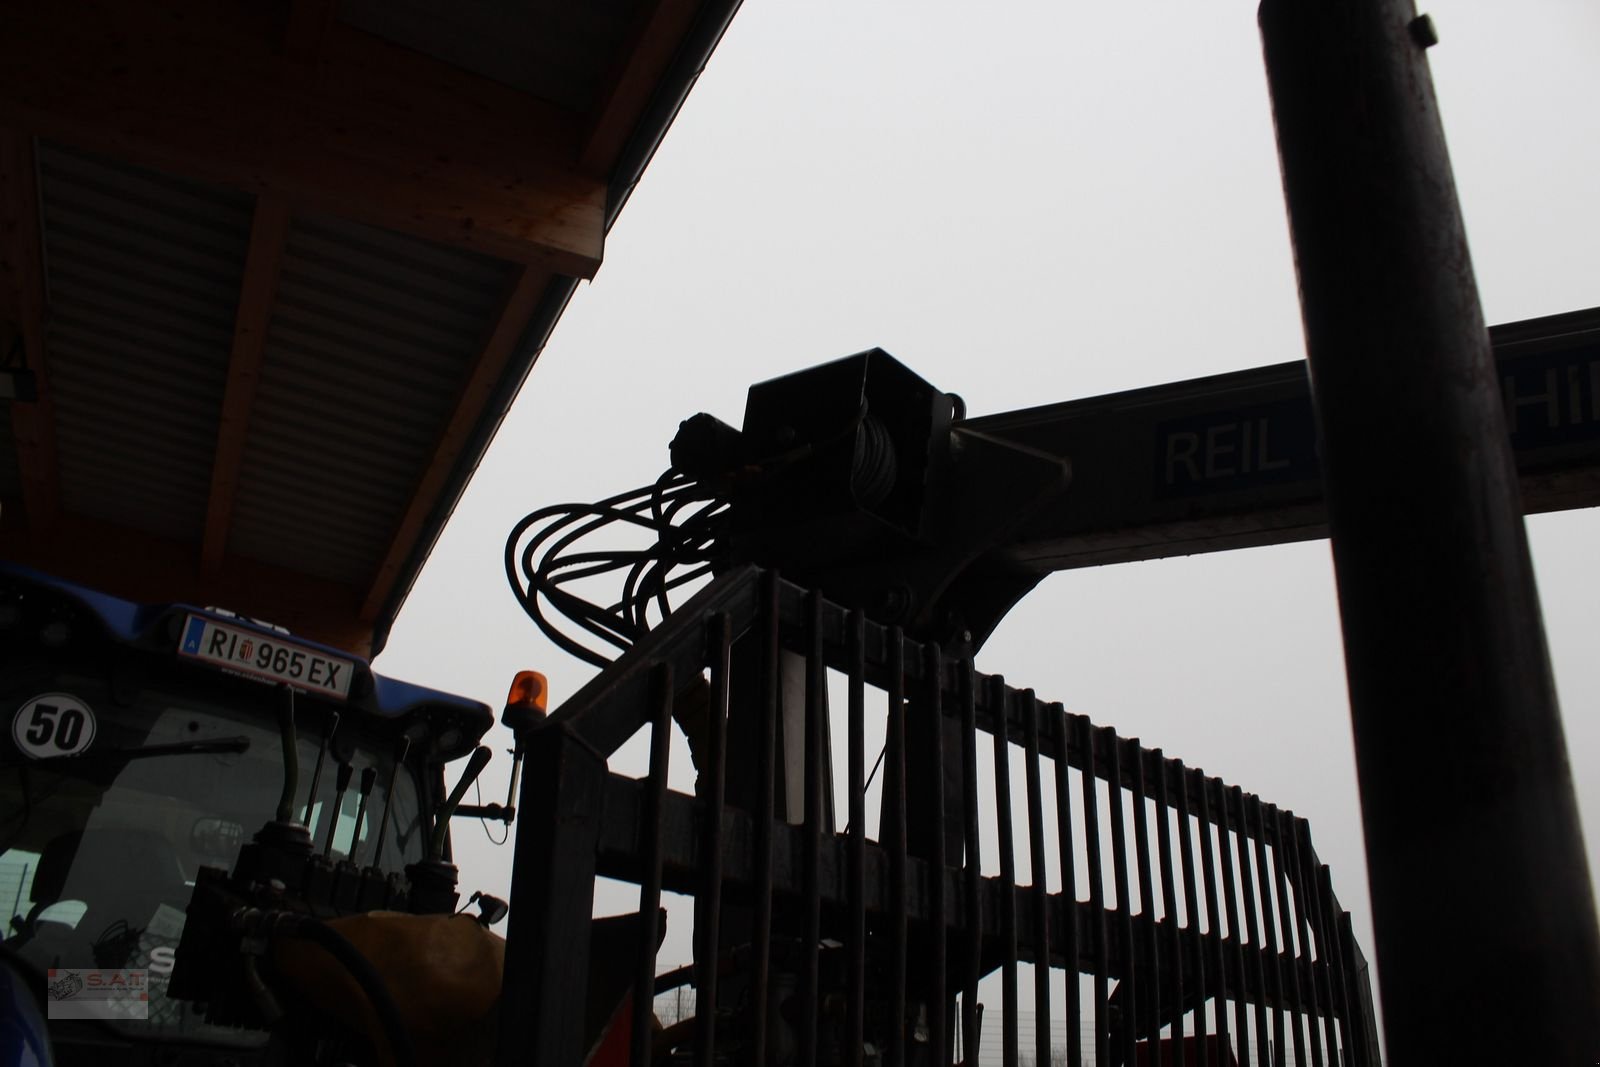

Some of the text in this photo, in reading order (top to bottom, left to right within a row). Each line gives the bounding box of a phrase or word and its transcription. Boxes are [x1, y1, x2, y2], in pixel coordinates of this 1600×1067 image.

[1166, 359, 1600, 485] REIL HI
[188, 640, 195, 649] A
[209, 629, 237, 660] RI
[256, 643, 306, 678] 965
[308, 658, 341, 689] EX
[26, 705, 84, 750] 50
